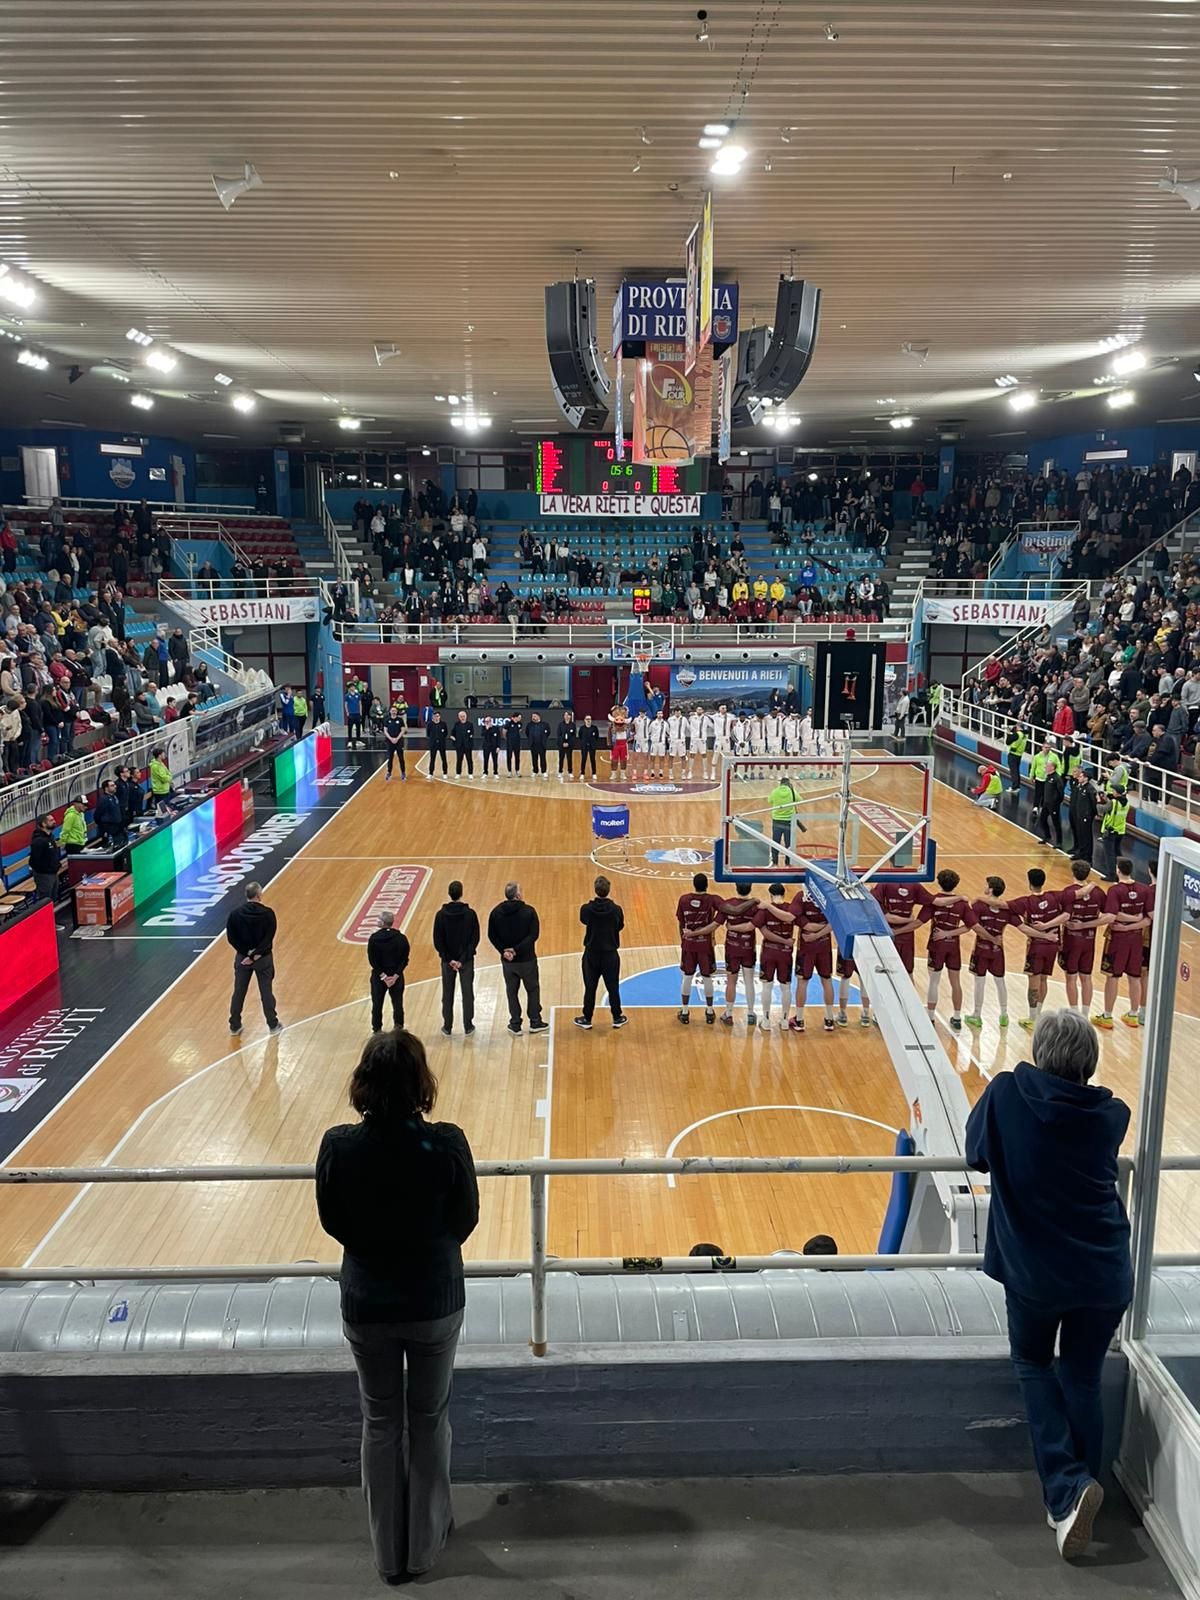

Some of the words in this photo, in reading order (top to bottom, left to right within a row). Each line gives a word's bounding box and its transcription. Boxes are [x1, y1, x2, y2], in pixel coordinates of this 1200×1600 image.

[628, 286, 733, 310] PROVIIA
[628, 314, 647, 336] DI
[654, 315, 699, 337] RIE
[607, 448, 614, 460] 0
[602, 481, 609, 491] 0
[635, 481, 641, 491] 0
[542, 496, 557, 513] LA
[562, 496, 591, 513] VERA
[595, 496, 630, 514] RIETI
[634, 496, 646, 514] E'
[650, 496, 699, 517] QUESTA
[200, 603, 290, 624] SEBASTIANI
[634, 598, 650, 611] 24
[953, 603, 1046, 624] SEBASTIANI
[699, 670, 748, 680] BENVENUTI
[751, 670, 758, 680] A
[760, 670, 782, 680] RIETI
[143, 813, 311, 926] PALASOJOURNER
[19, 1007, 106, 1060] RIETI
[17, 1064, 46, 1076] di
